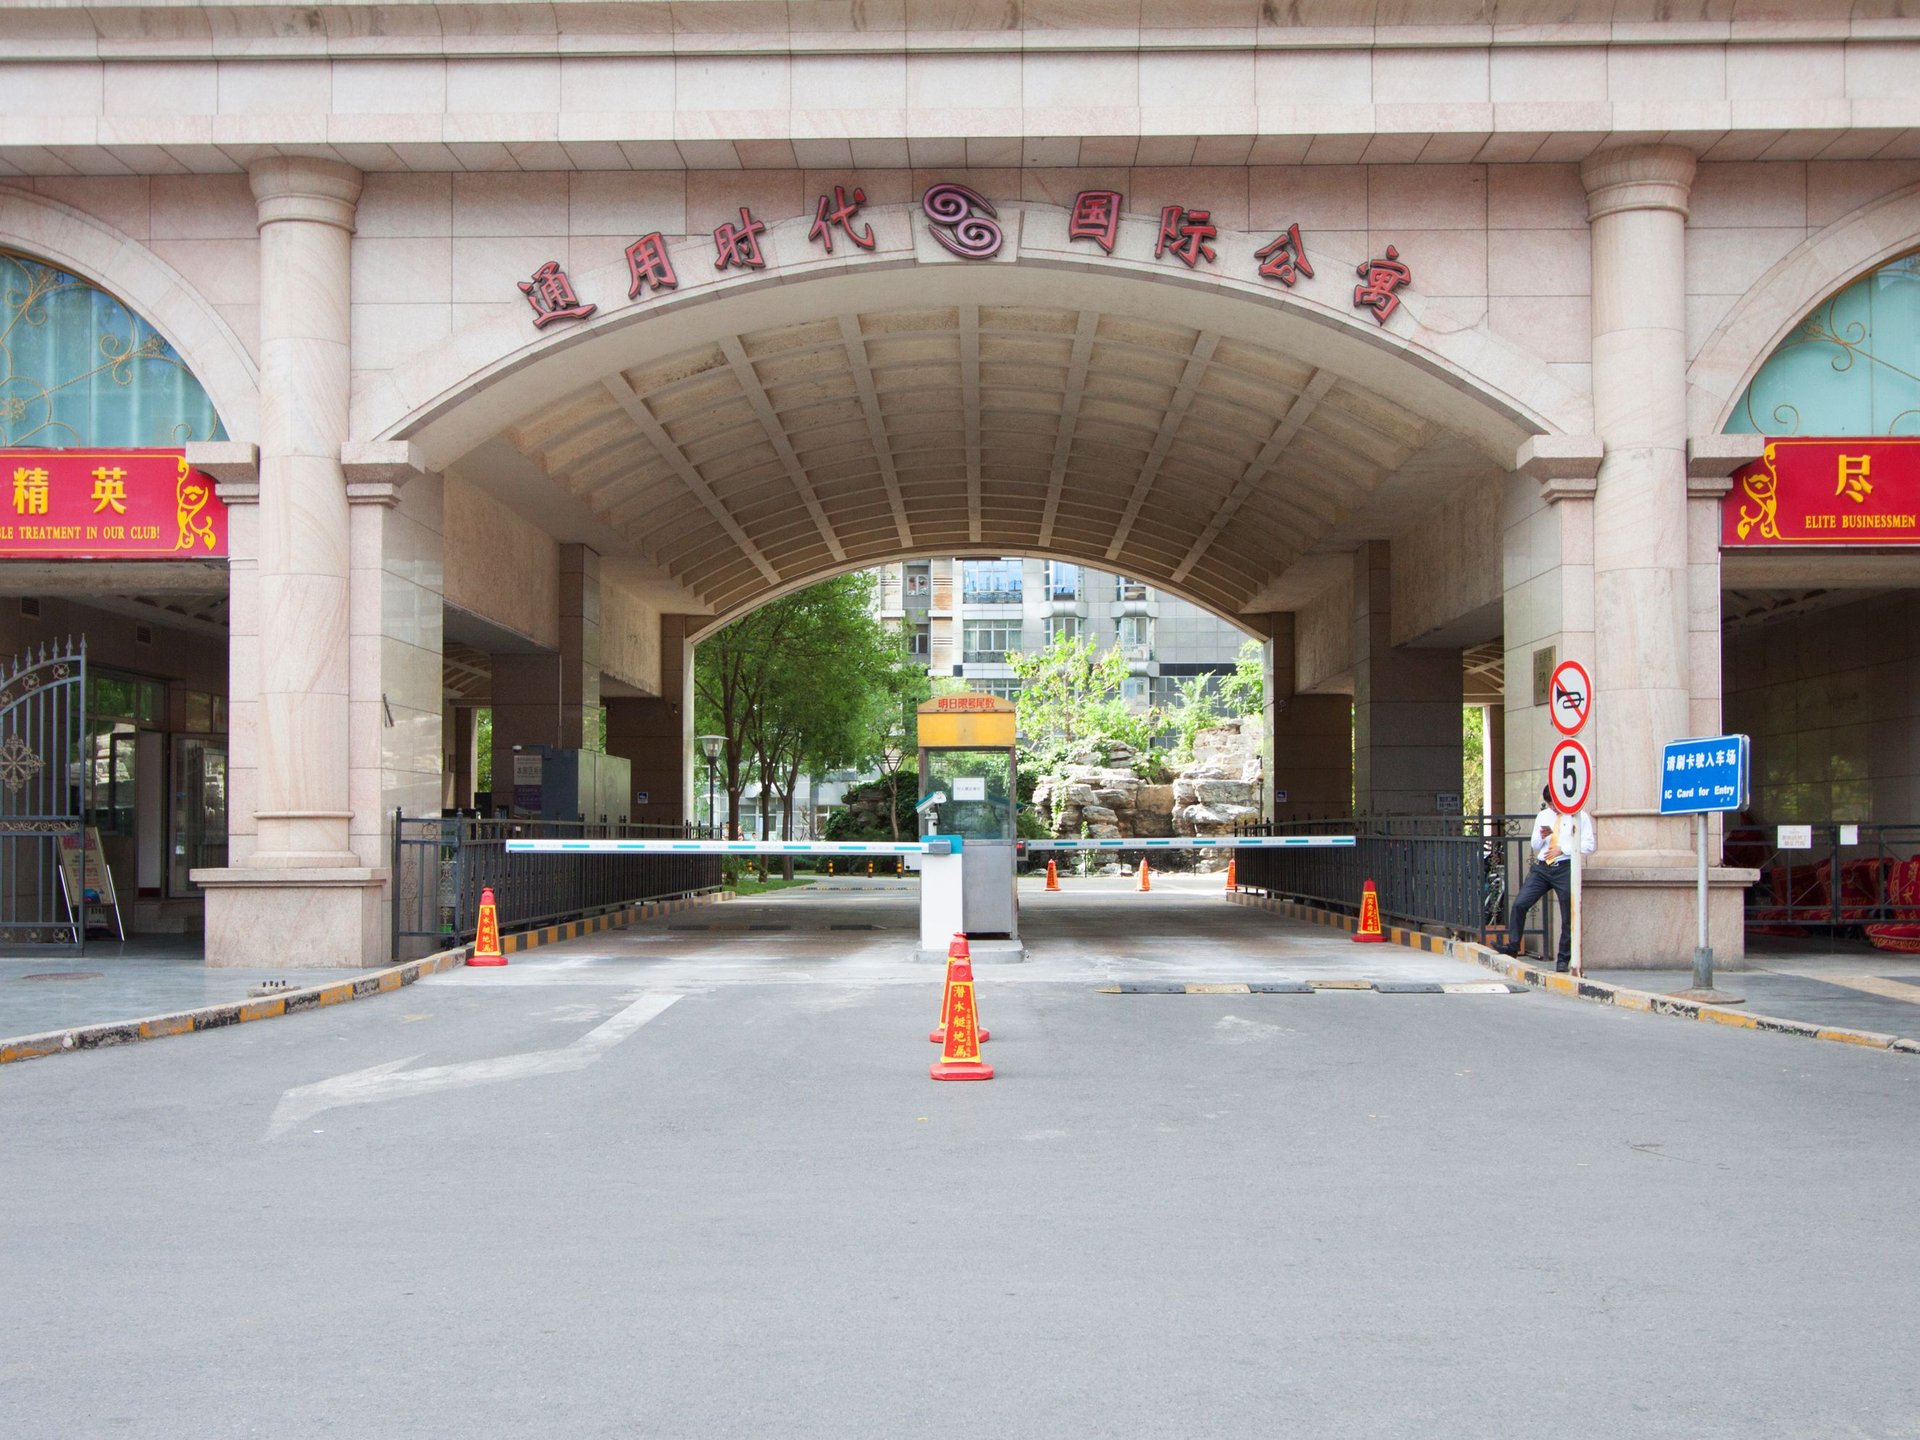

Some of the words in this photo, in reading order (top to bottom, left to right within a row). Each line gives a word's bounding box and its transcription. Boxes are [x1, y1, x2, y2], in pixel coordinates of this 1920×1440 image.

[517, 185, 876, 329] 通用时代
[1068, 190, 1411, 326] 国际公寓
[13, 467, 128, 514] 精英
[1835, 454, 1873, 503] 尽
[0, 526, 14, 540] LE
[19, 526, 81, 540] TREATMENT
[86, 526, 98, 540] IN
[103, 526, 125, 540] OUR
[130, 526, 160, 540] CLUB!
[1805, 515, 1837, 529] ELITE
[1842, 515, 1916, 529] BUSINESSMEN
[1666, 749, 1737, 771] 请刷卡驶入车场
[1563, 755, 1577, 798] 5
[1664, 790, 1673, 799] IC
[1676, 788, 1695, 798] Card
[1698, 786, 1710, 797] for
[1714, 785, 1735, 797] Entry
